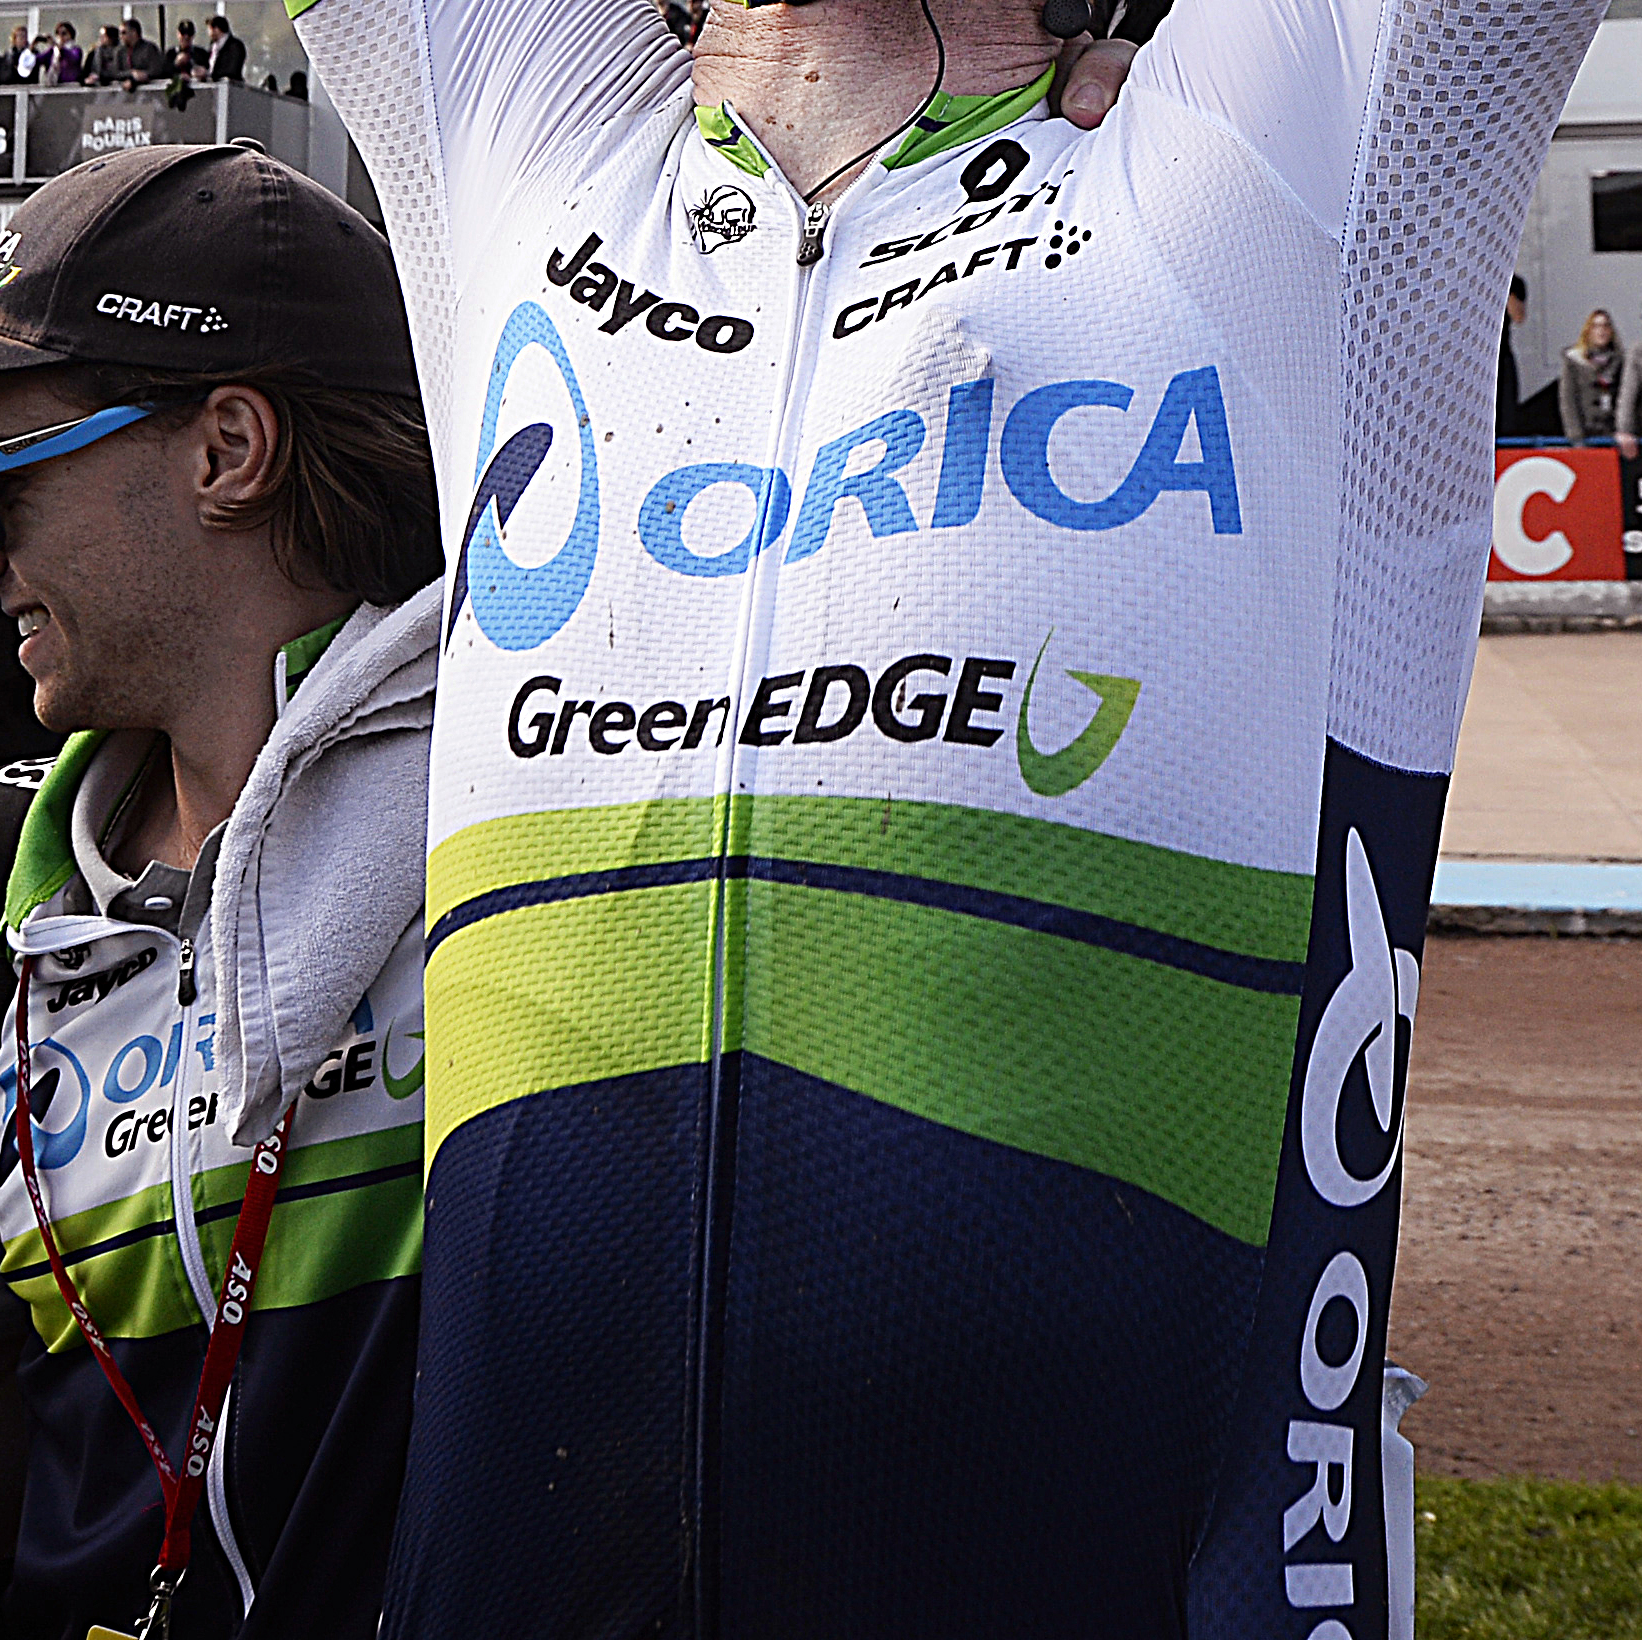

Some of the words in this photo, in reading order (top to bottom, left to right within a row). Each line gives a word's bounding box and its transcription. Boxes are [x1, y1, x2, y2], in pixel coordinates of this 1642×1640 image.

[96, 293, 202, 330] CRAFT
[547, 232, 755, 354] Jayco
[833, 236, 1038, 339] CRAFT
[638, 365, 1243, 578] ORICA
[507, 654, 1017, 760] GreenEDGE
